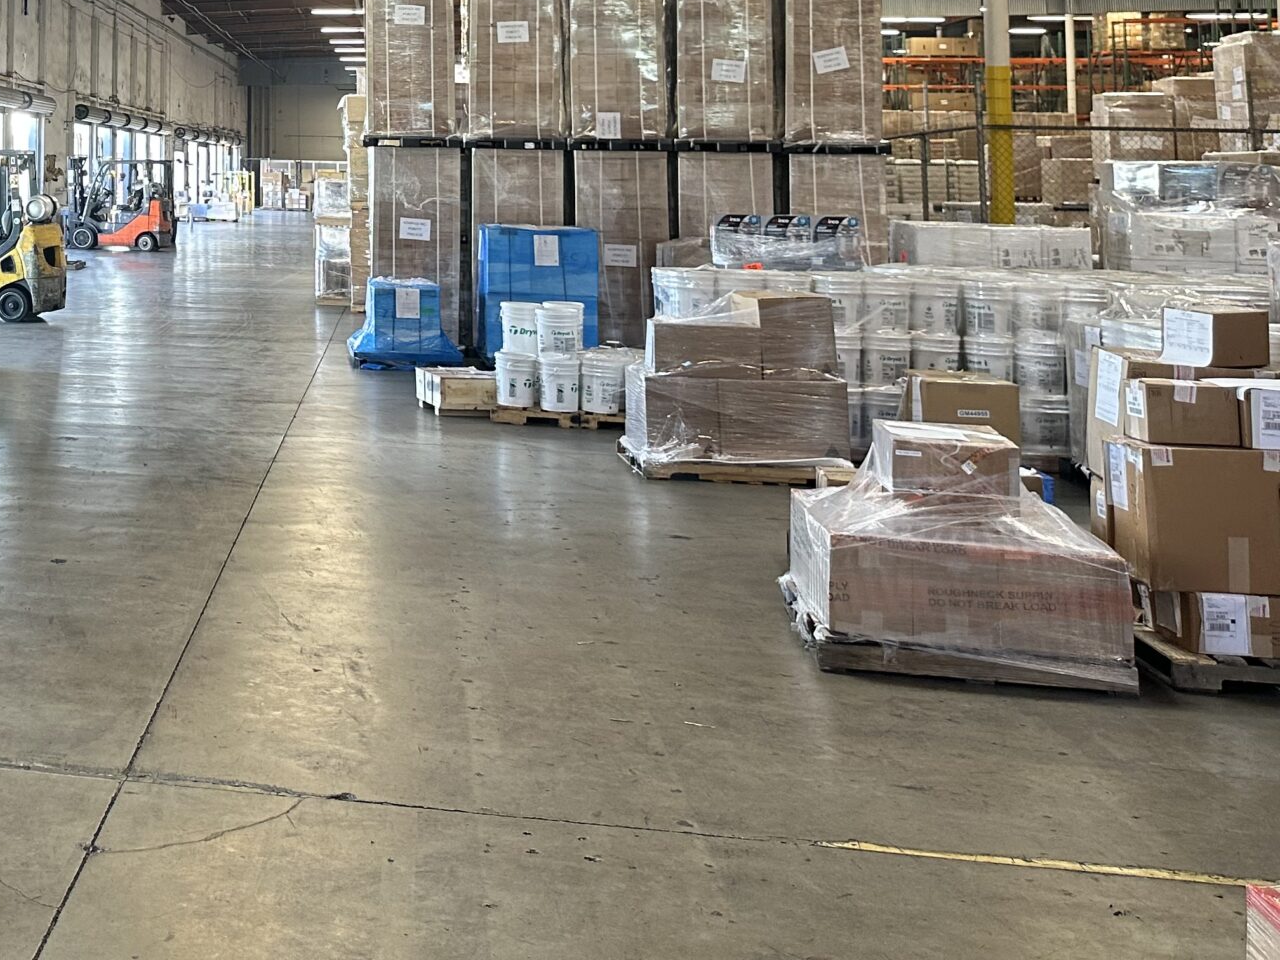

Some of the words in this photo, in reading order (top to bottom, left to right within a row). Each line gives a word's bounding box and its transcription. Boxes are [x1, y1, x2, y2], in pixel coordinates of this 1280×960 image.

[927, 588, 1004, 600] ROUGHNECK
[929, 598, 946, 608] DO
[949, 599, 972, 609] NOT
[977, 599, 1019, 611] BREAK
[1023, 602, 1057, 612] LOAD
